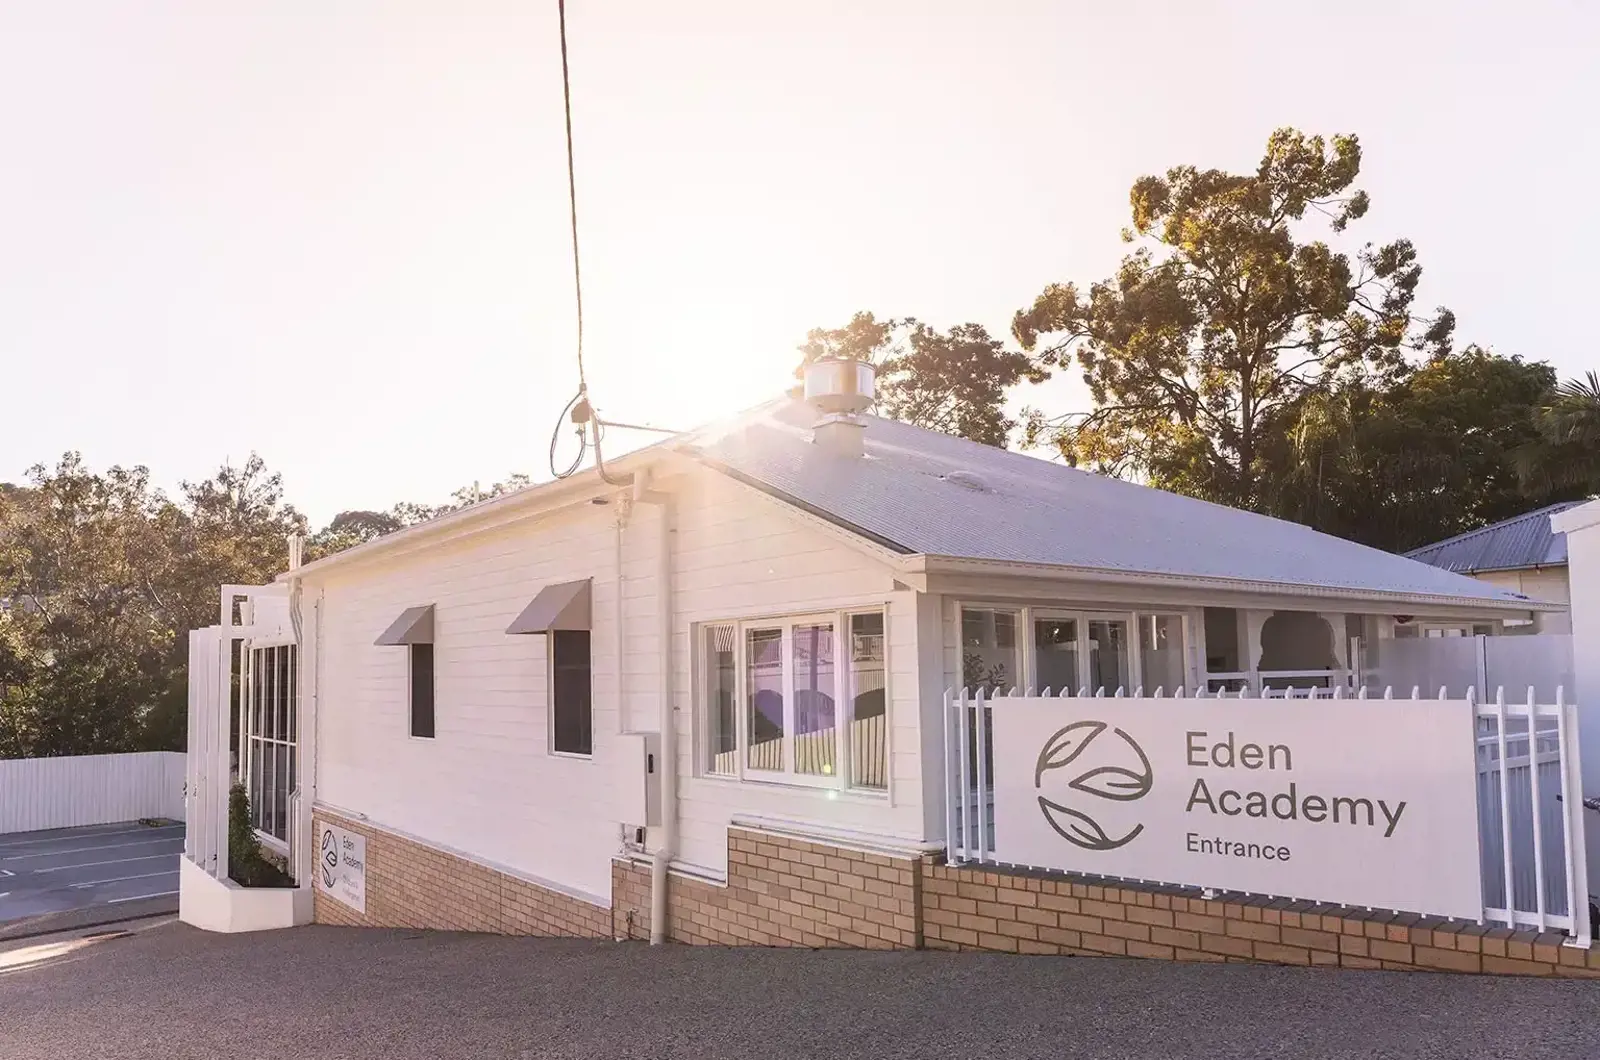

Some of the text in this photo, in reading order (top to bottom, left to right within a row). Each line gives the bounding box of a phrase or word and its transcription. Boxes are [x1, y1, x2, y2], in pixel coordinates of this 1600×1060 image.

[1186, 731, 1292, 771] Eden
[1185, 777, 1407, 838] Academy
[343, 835, 355, 850] Eden
[1186, 832, 1291, 862] Entrance
[343, 851, 363, 874] Academy
